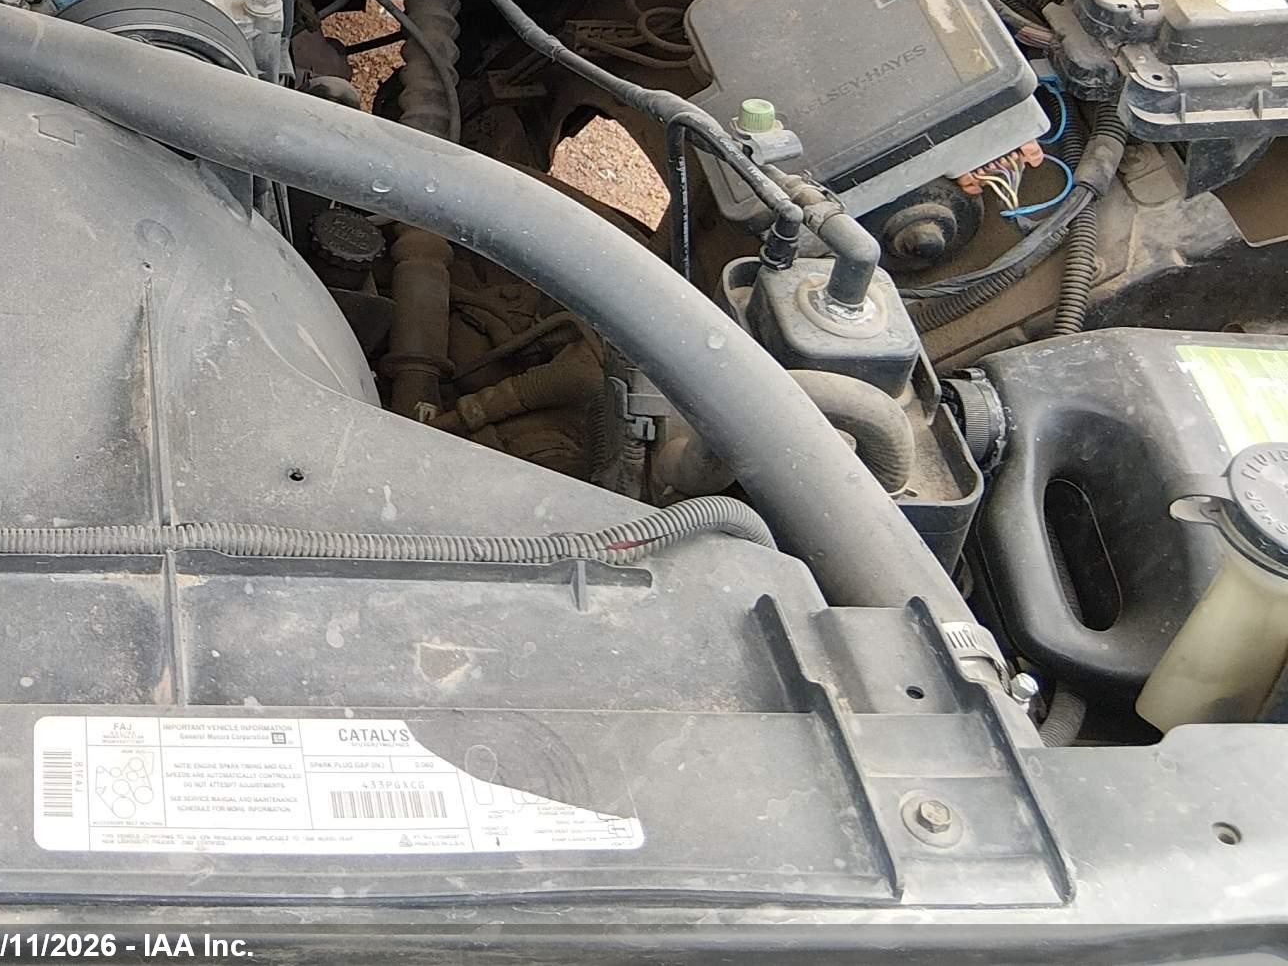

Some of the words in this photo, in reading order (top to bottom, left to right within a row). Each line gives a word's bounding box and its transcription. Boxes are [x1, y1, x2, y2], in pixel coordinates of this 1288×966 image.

[798, 44, 927, 116] KELSEY-HAYES
[113, 722, 132, 731] FAJ
[163, 723, 205, 731] IMPORTANT
[240, 724, 292, 732] INFORMATION
[338, 728, 410, 742] CATALYS
